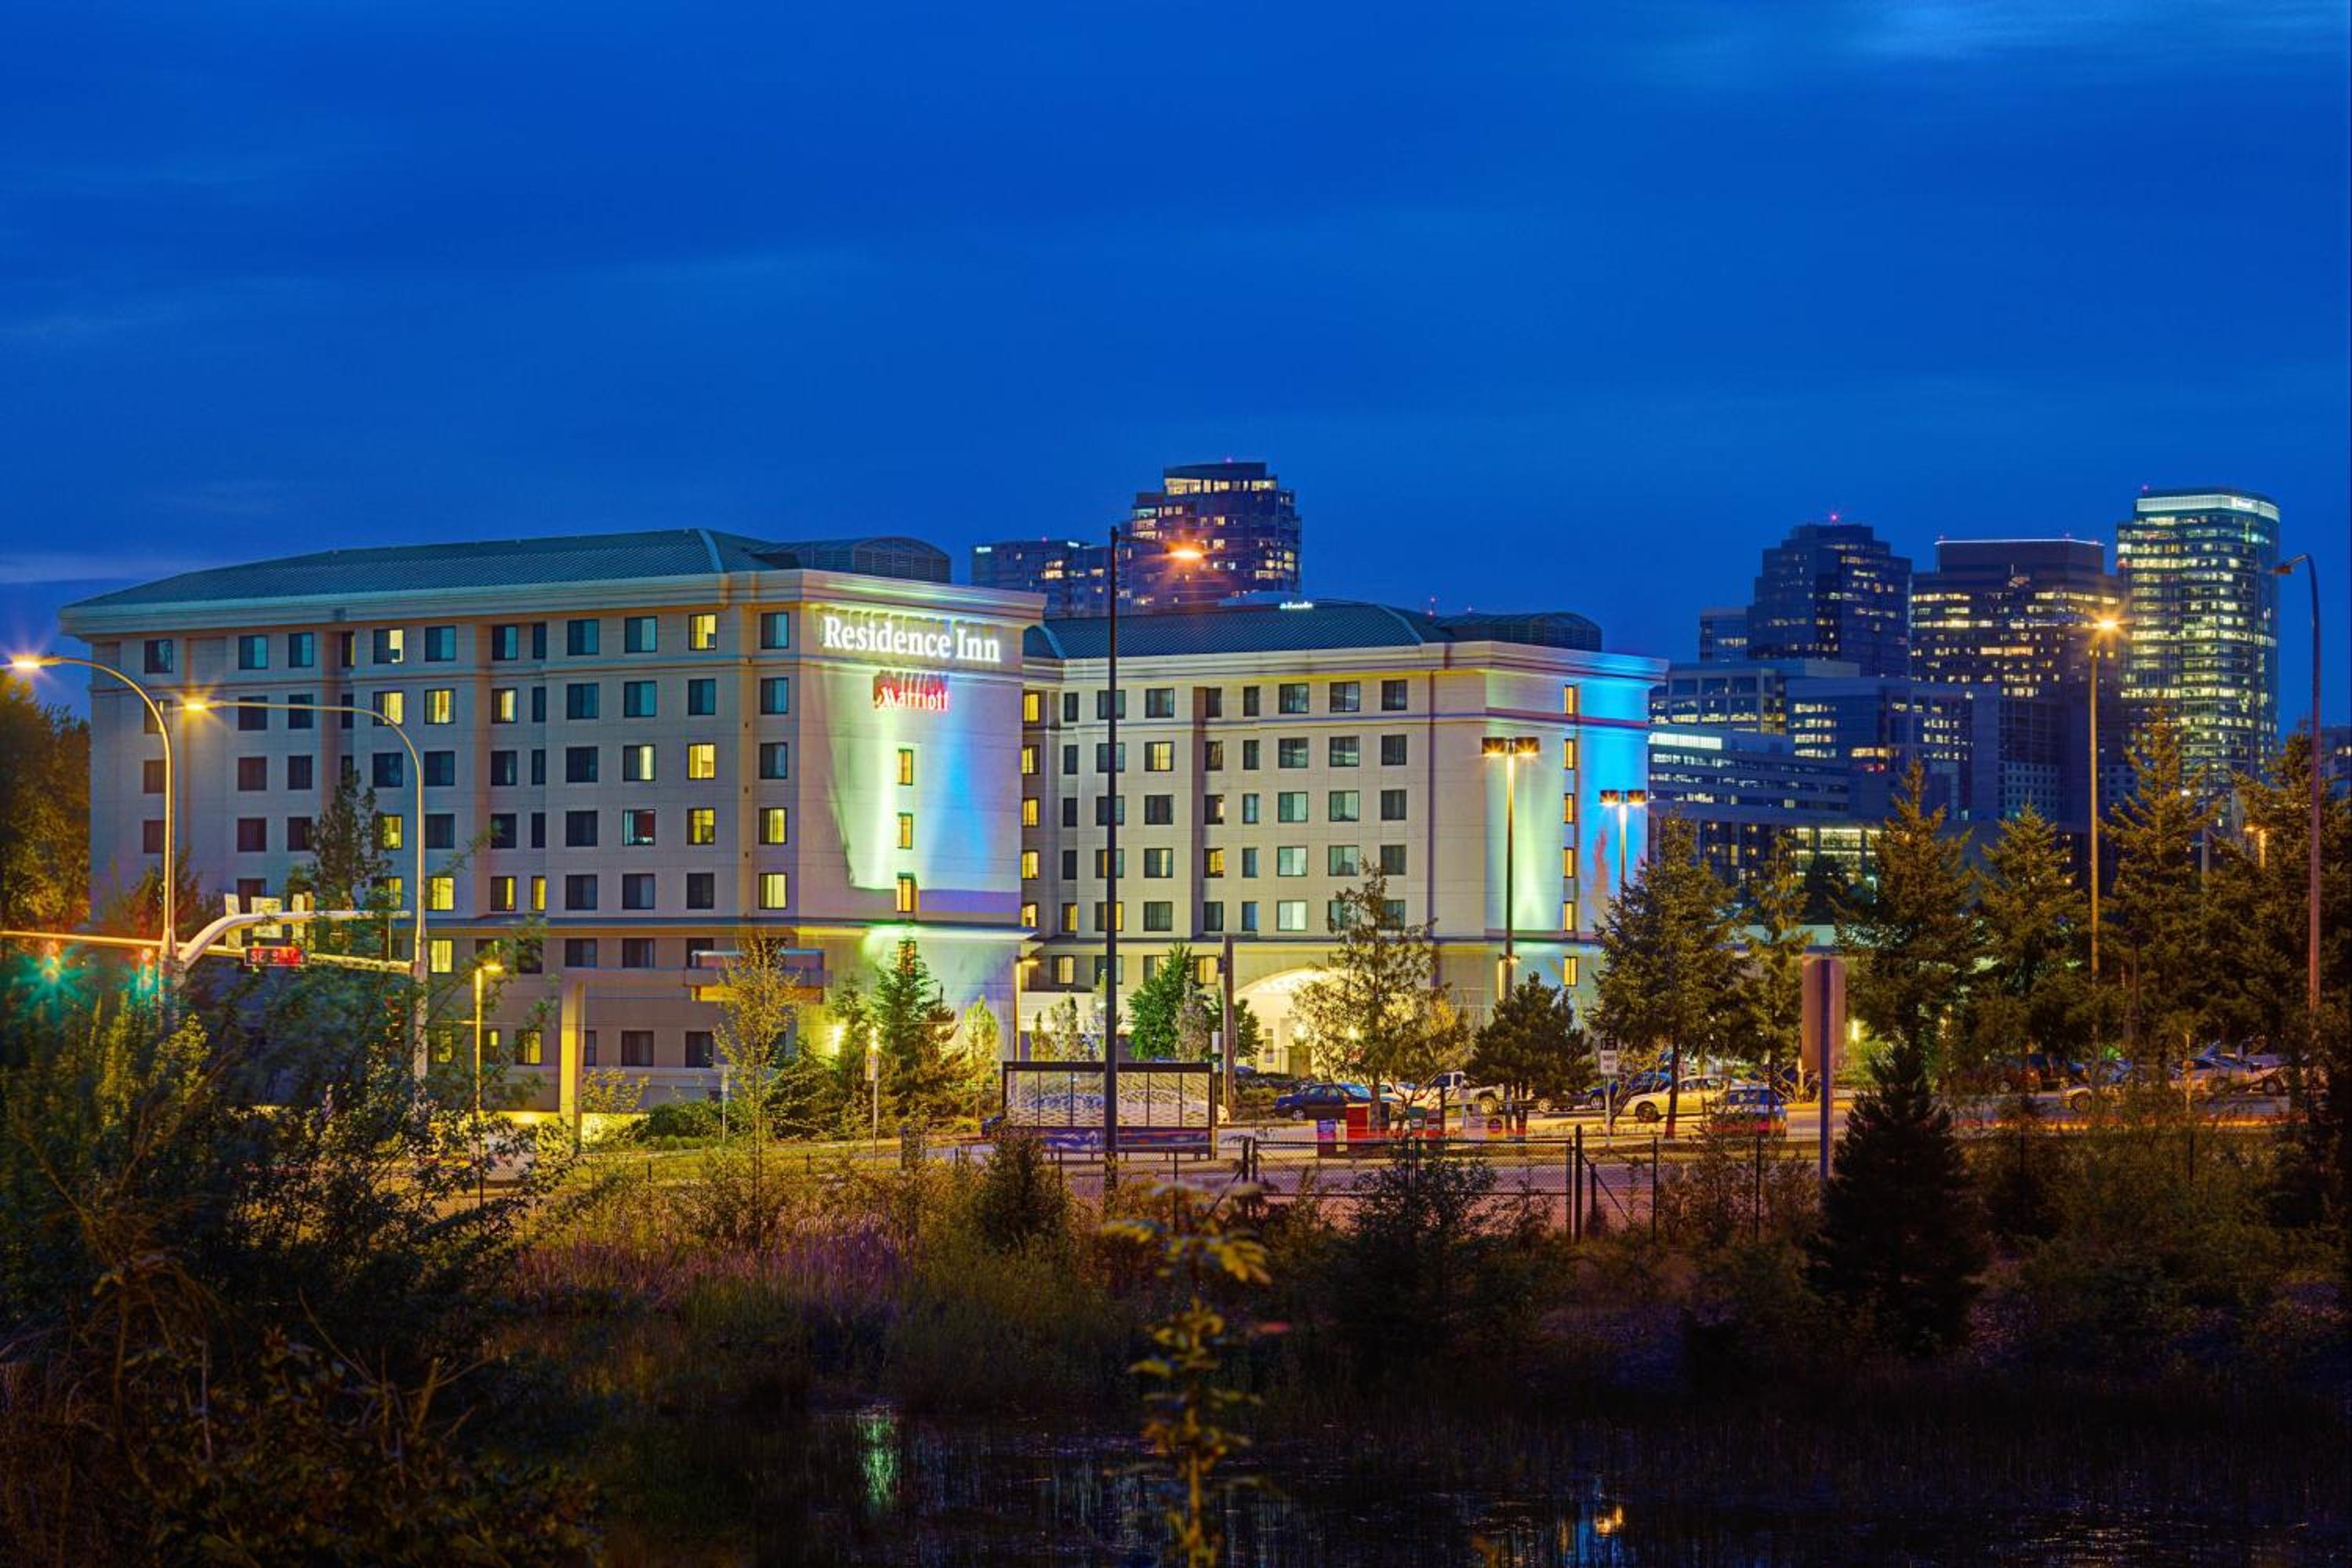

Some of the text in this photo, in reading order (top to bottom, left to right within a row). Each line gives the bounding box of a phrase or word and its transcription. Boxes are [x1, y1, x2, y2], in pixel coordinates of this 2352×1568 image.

[823, 615, 1001, 662] Residence Inn
[875, 685, 949, 711] Marriott
